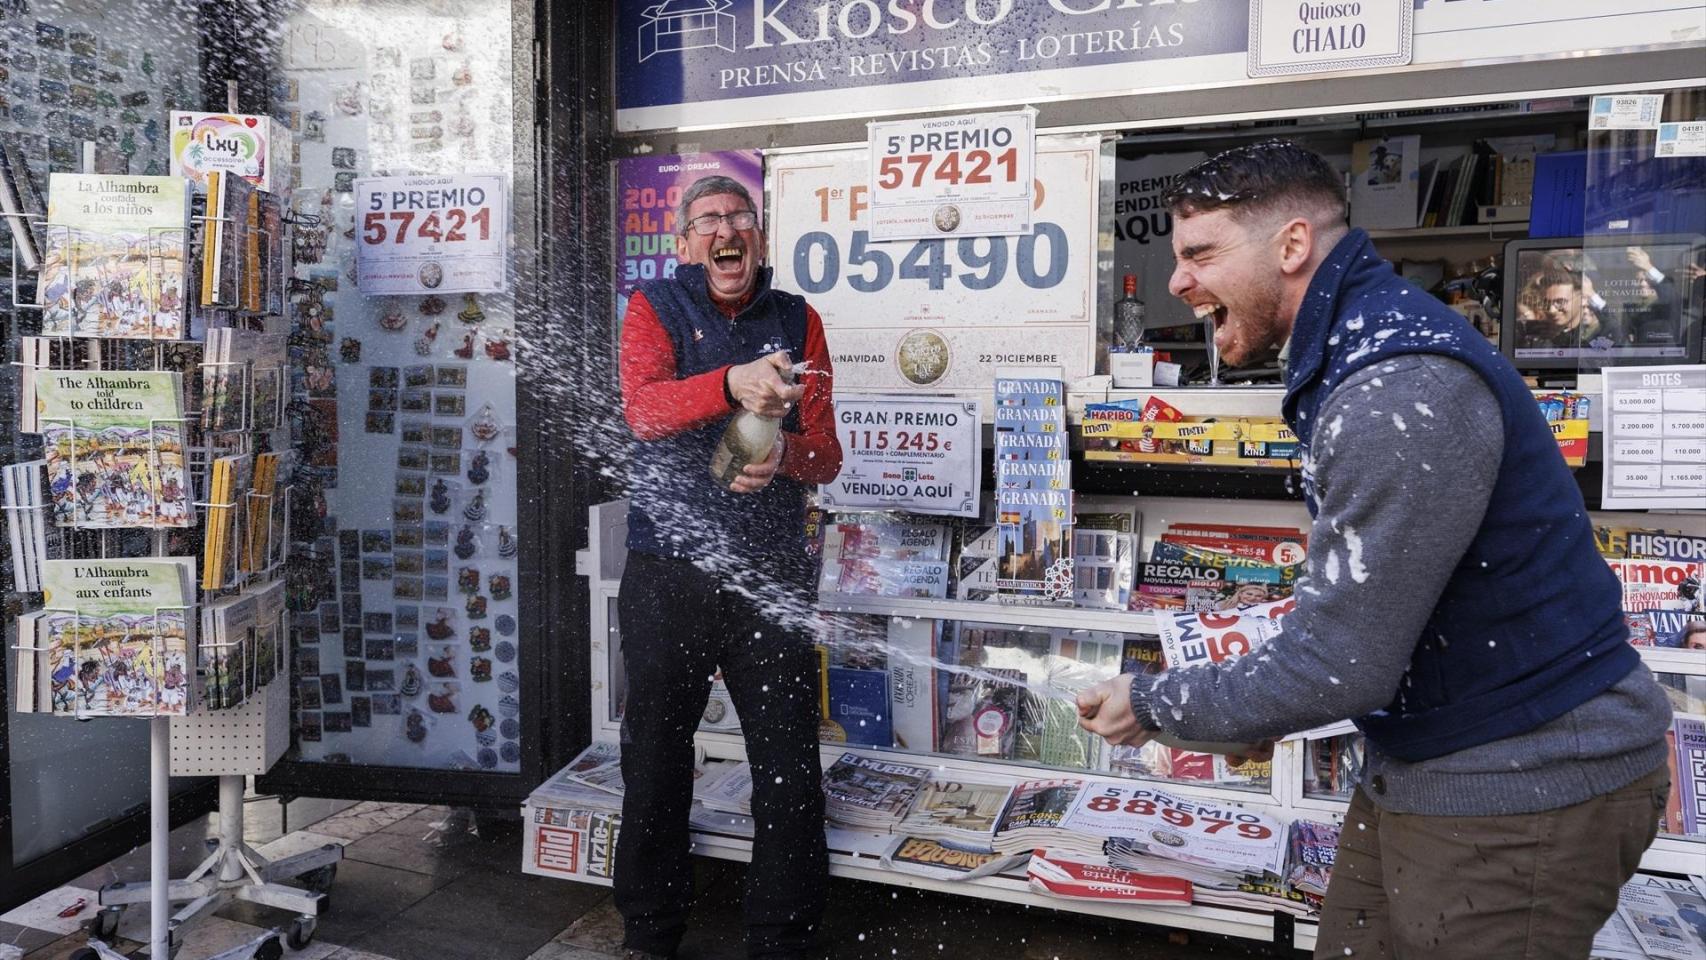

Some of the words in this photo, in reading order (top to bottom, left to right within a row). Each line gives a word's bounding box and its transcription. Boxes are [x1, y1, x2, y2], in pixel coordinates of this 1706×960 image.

[1299, 1, 1361, 21] Quiosco
[1292, 23, 1366, 54] CHALO
[719, 60, 824, 90] PRENSA
[849, 42, 991, 77] REVISTAS
[1018, 20, 1184, 62] LOTERÍAS
[910, 127, 1012, 153] PREMIO
[658, 164, 680, 173] EURO
[687, 162, 721, 171] DREAMS
[878, 148, 1017, 190] 57421
[78, 181, 93, 193] La
[96, 181, 159, 194] Alhambra
[101, 194, 136, 204] contada
[392, 187, 486, 210] PREMIO
[83, 205, 91, 214] a
[94, 203, 113, 215] los
[117, 202, 153, 215] niños
[363, 207, 490, 245] 57421
[624, 211, 658, 234] AL
[793, 221, 1070, 295] 05490
[624, 259, 657, 281] 30
[979, 354, 992, 363] 22
[995, 354, 1058, 364] DICIEMBRE
[57, 377, 83, 390] The
[86, 377, 151, 391] Alhambra
[1642, 373, 1682, 386] BOTES
[97, 389, 115, 398] told
[998, 381, 1058, 395] GRANADA
[70, 400, 84, 410] to
[87, 398, 143, 410] children
[841, 411, 888, 425] GRAN
[894, 412, 958, 427] PREMIO
[997, 408, 1058, 421] GRANADA
[1091, 410, 1135, 421] HARIBO
[1000, 434, 1062, 448] GRANADA
[890, 450, 945, 458] COMPLEMENTARIO
[1244, 447, 1266, 456] KIND
[1001, 462, 1064, 477] GRANADA
[842, 482, 908, 497] VENDIDO
[913, 483, 953, 498] AQUÍ
[1001, 491, 1067, 507] GRANADA
[901, 528, 937, 538] REGALO
[901, 538, 936, 547] AGENDA
[74, 566, 149, 579] L'Alhambra
[903, 565, 942, 575] REGALO
[1144, 564, 1220, 580] REGALO
[902, 575, 941, 585] AGENDA
[1144, 577, 1173, 585] NOVELA
[76, 588, 101, 599] aux
[103, 586, 153, 599] enfants
[1149, 586, 1171, 594] TODO
[1630, 588, 1680, 601] RENOVACIÓN
[841, 754, 858, 766] EL
[858, 759, 926, 778] MUEBLE
[1133, 789, 1262, 824] PREMIO
[1087, 796, 1272, 840] 88979
[540, 829, 574, 871] Bild
